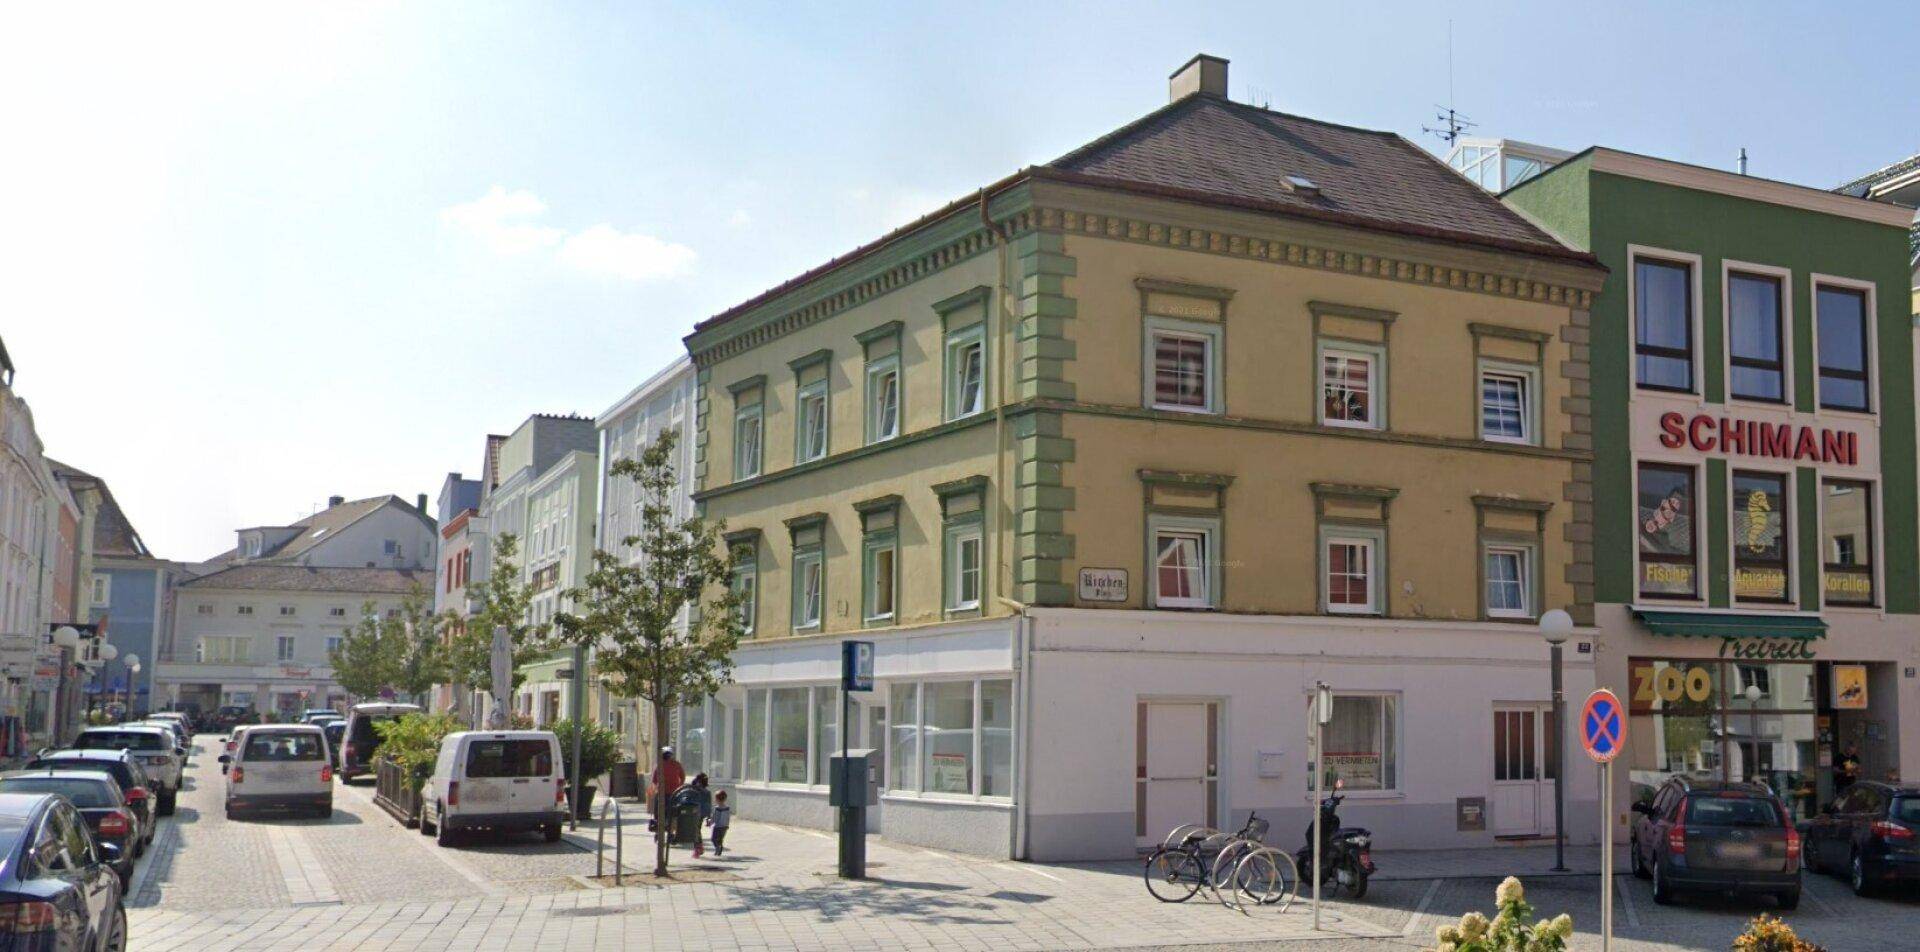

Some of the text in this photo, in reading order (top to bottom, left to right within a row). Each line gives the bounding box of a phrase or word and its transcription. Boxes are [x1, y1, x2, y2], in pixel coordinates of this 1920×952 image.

[1660, 412, 1857, 465] SCHIMANI
[1823, 574, 1871, 593] Korallen
[1634, 666, 1711, 702] ZOO
